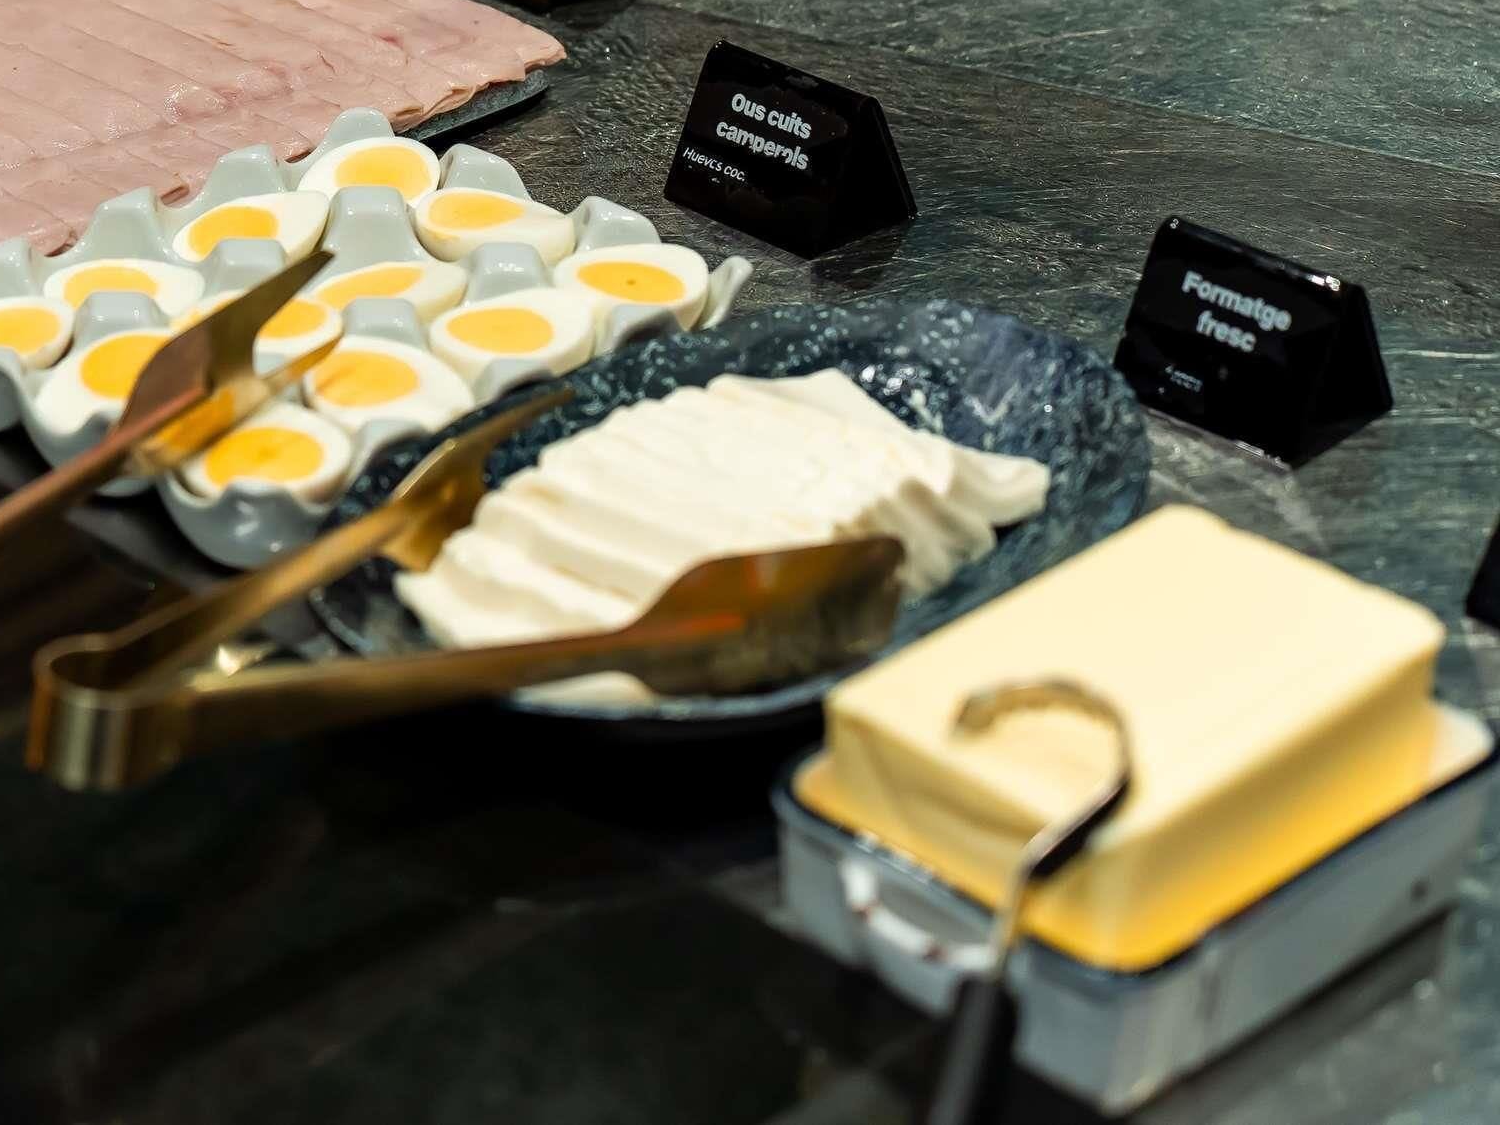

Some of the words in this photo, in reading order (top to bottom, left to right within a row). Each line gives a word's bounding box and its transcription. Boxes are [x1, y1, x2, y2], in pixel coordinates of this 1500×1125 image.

[731, 93, 767, 122] Ous
[767, 112, 812, 140] cuits
[1181, 270, 1293, 332] Formatge
[1195, 310, 1257, 353] fresc
